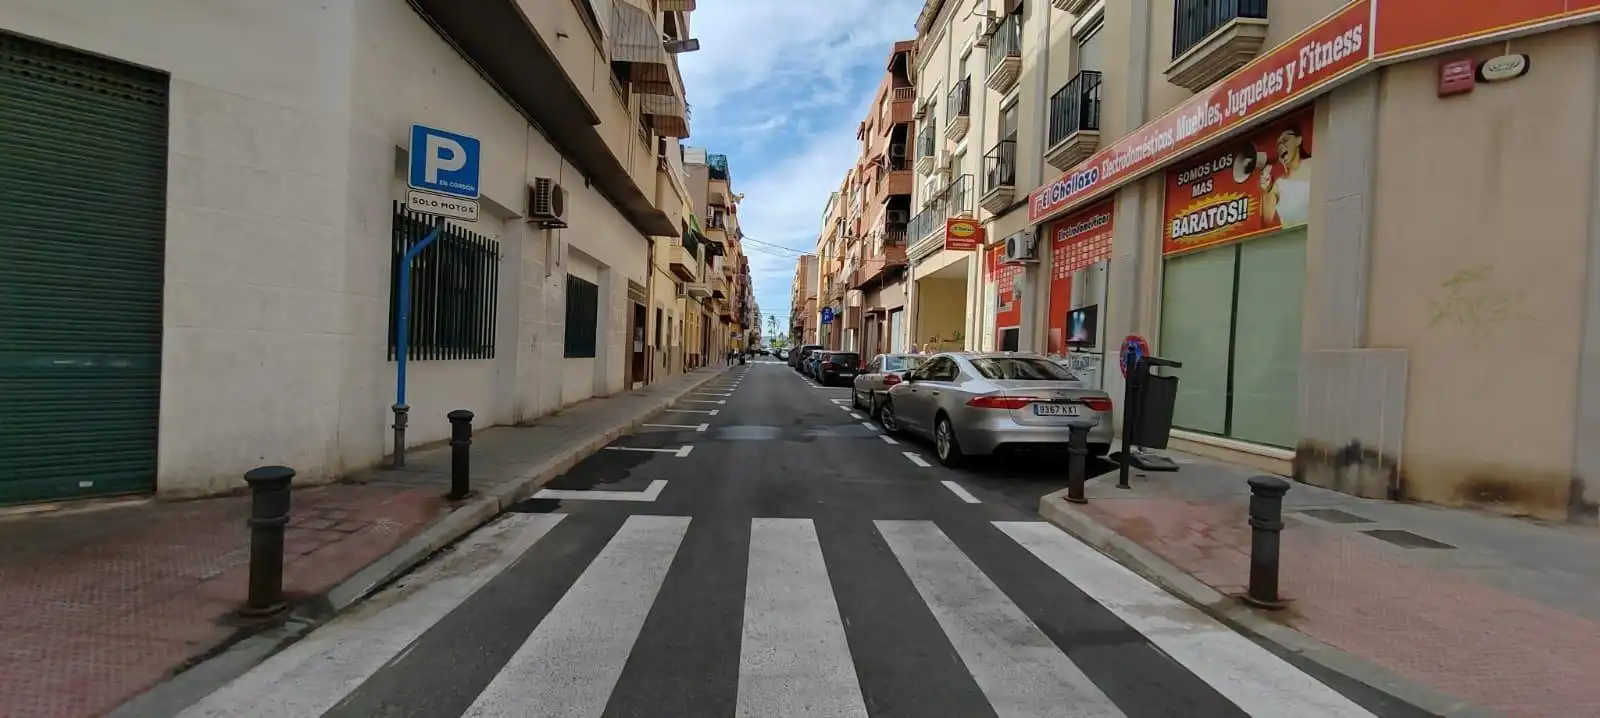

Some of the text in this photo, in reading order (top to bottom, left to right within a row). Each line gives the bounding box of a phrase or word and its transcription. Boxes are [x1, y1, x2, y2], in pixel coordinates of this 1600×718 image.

[1042, 188, 1051, 209] El
[1051, 166, 1100, 204] Chollazo
[1175, 100, 1223, 142] Muebles,
[1225, 66, 1284, 116] Juguetes
[1284, 60, 1297, 93] y
[1298, 23, 1363, 79] Fitness
[425, 133, 467, 184] P
[1178, 153, 1233, 186] SOMOS LOS
[1192, 179, 1213, 197] MAS
[412, 197, 474, 213] SOLO MOTOS
[1171, 198, 1249, 239] BARATOS!!
[1039, 405, 1060, 414] 9367
